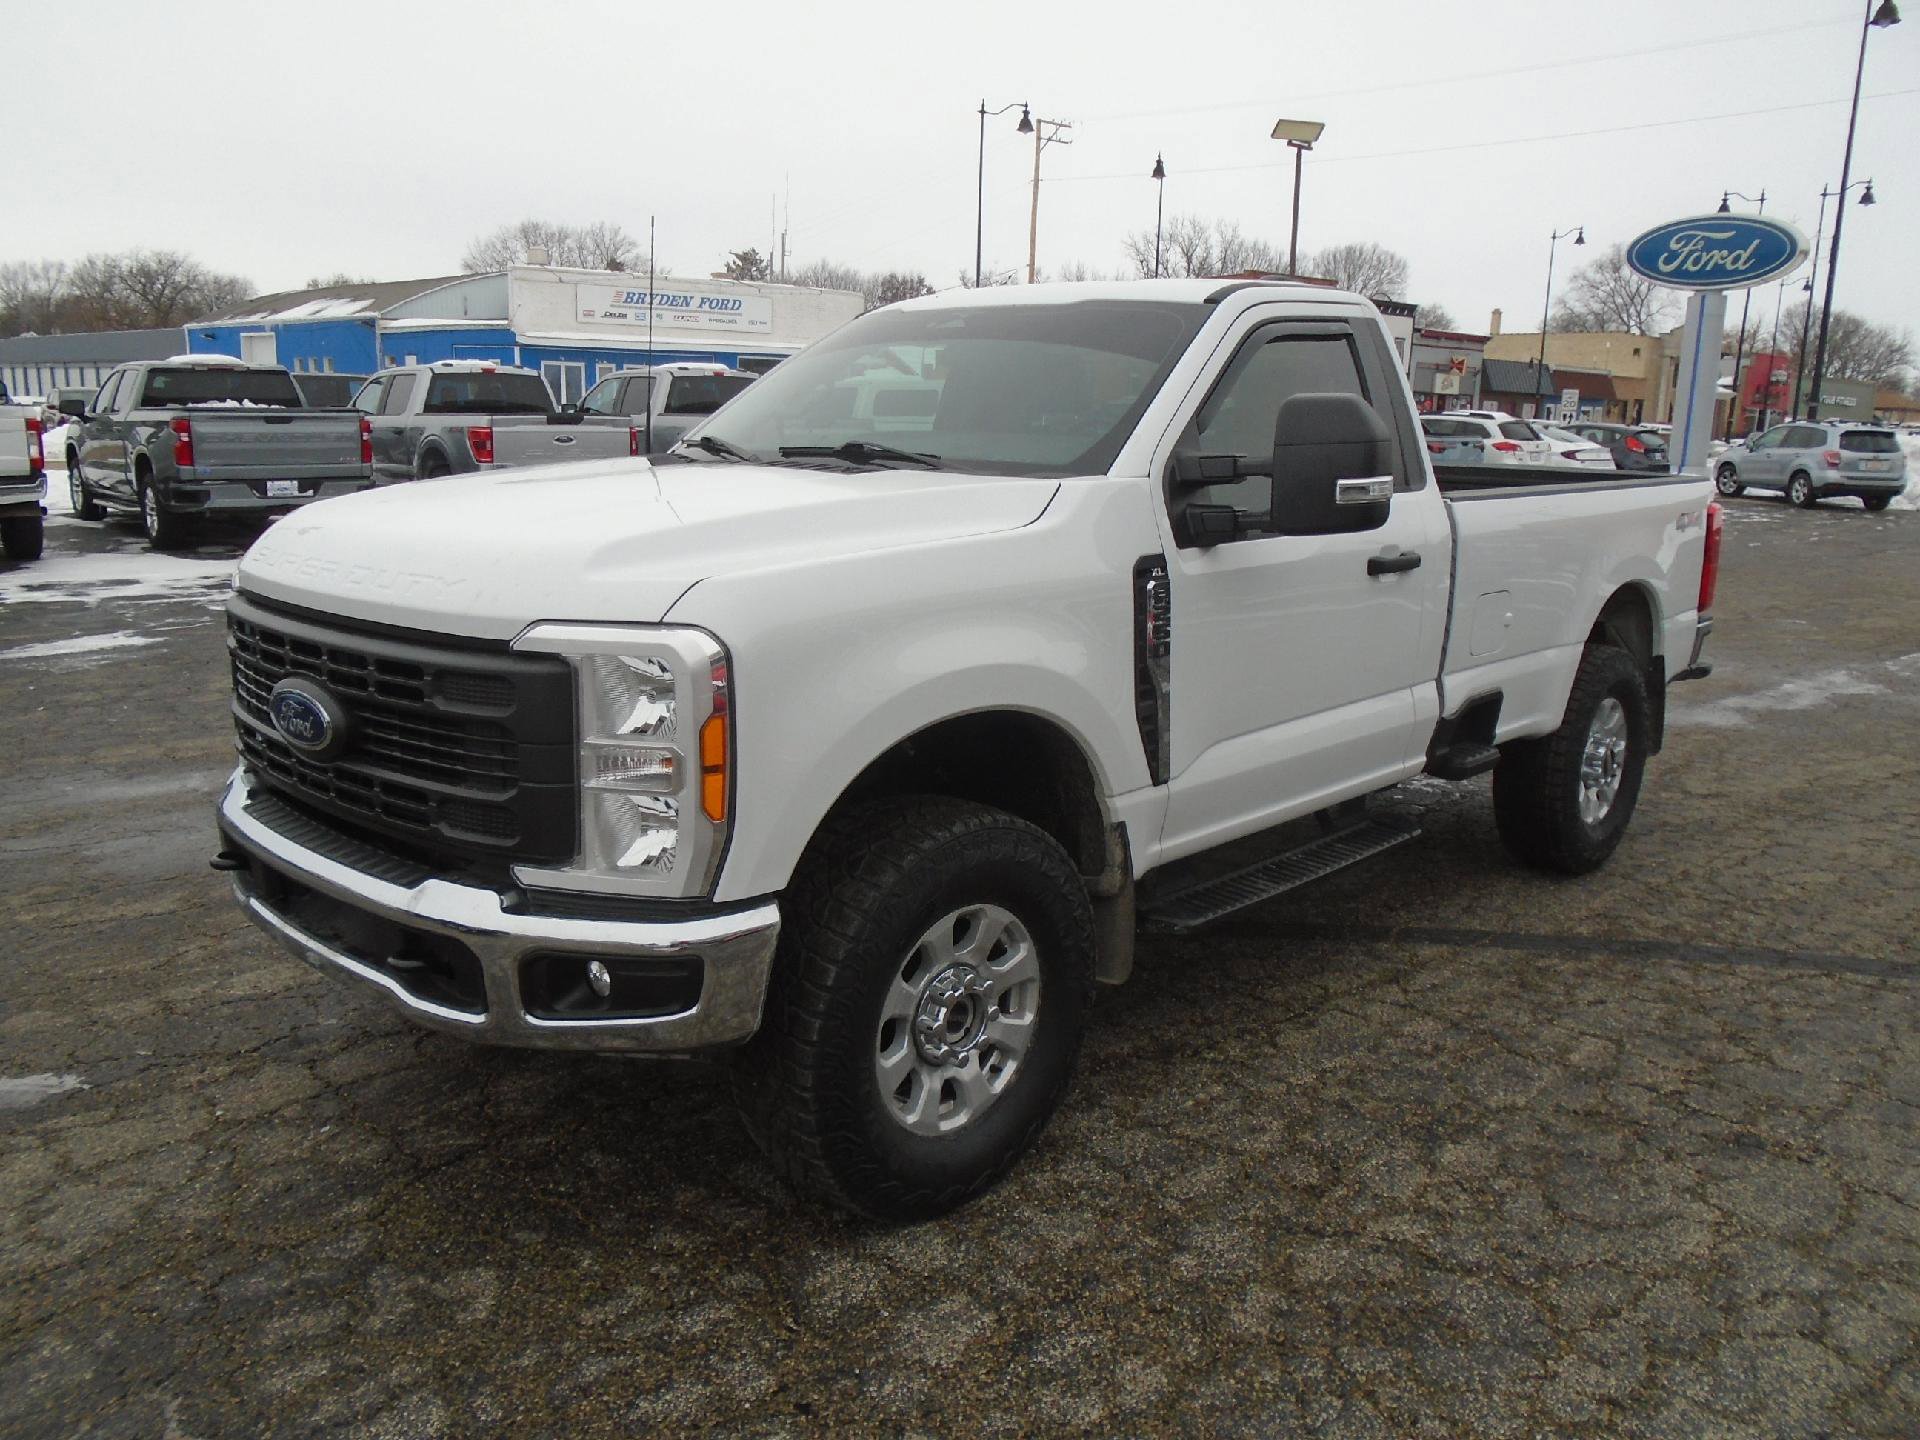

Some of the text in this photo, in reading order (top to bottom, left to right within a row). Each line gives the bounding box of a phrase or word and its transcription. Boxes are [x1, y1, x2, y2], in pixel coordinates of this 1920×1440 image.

[1659, 230, 1760, 272] Ford
[623, 291, 742, 311] BRYDEN FORD
[280, 700, 315, 736] Ford
